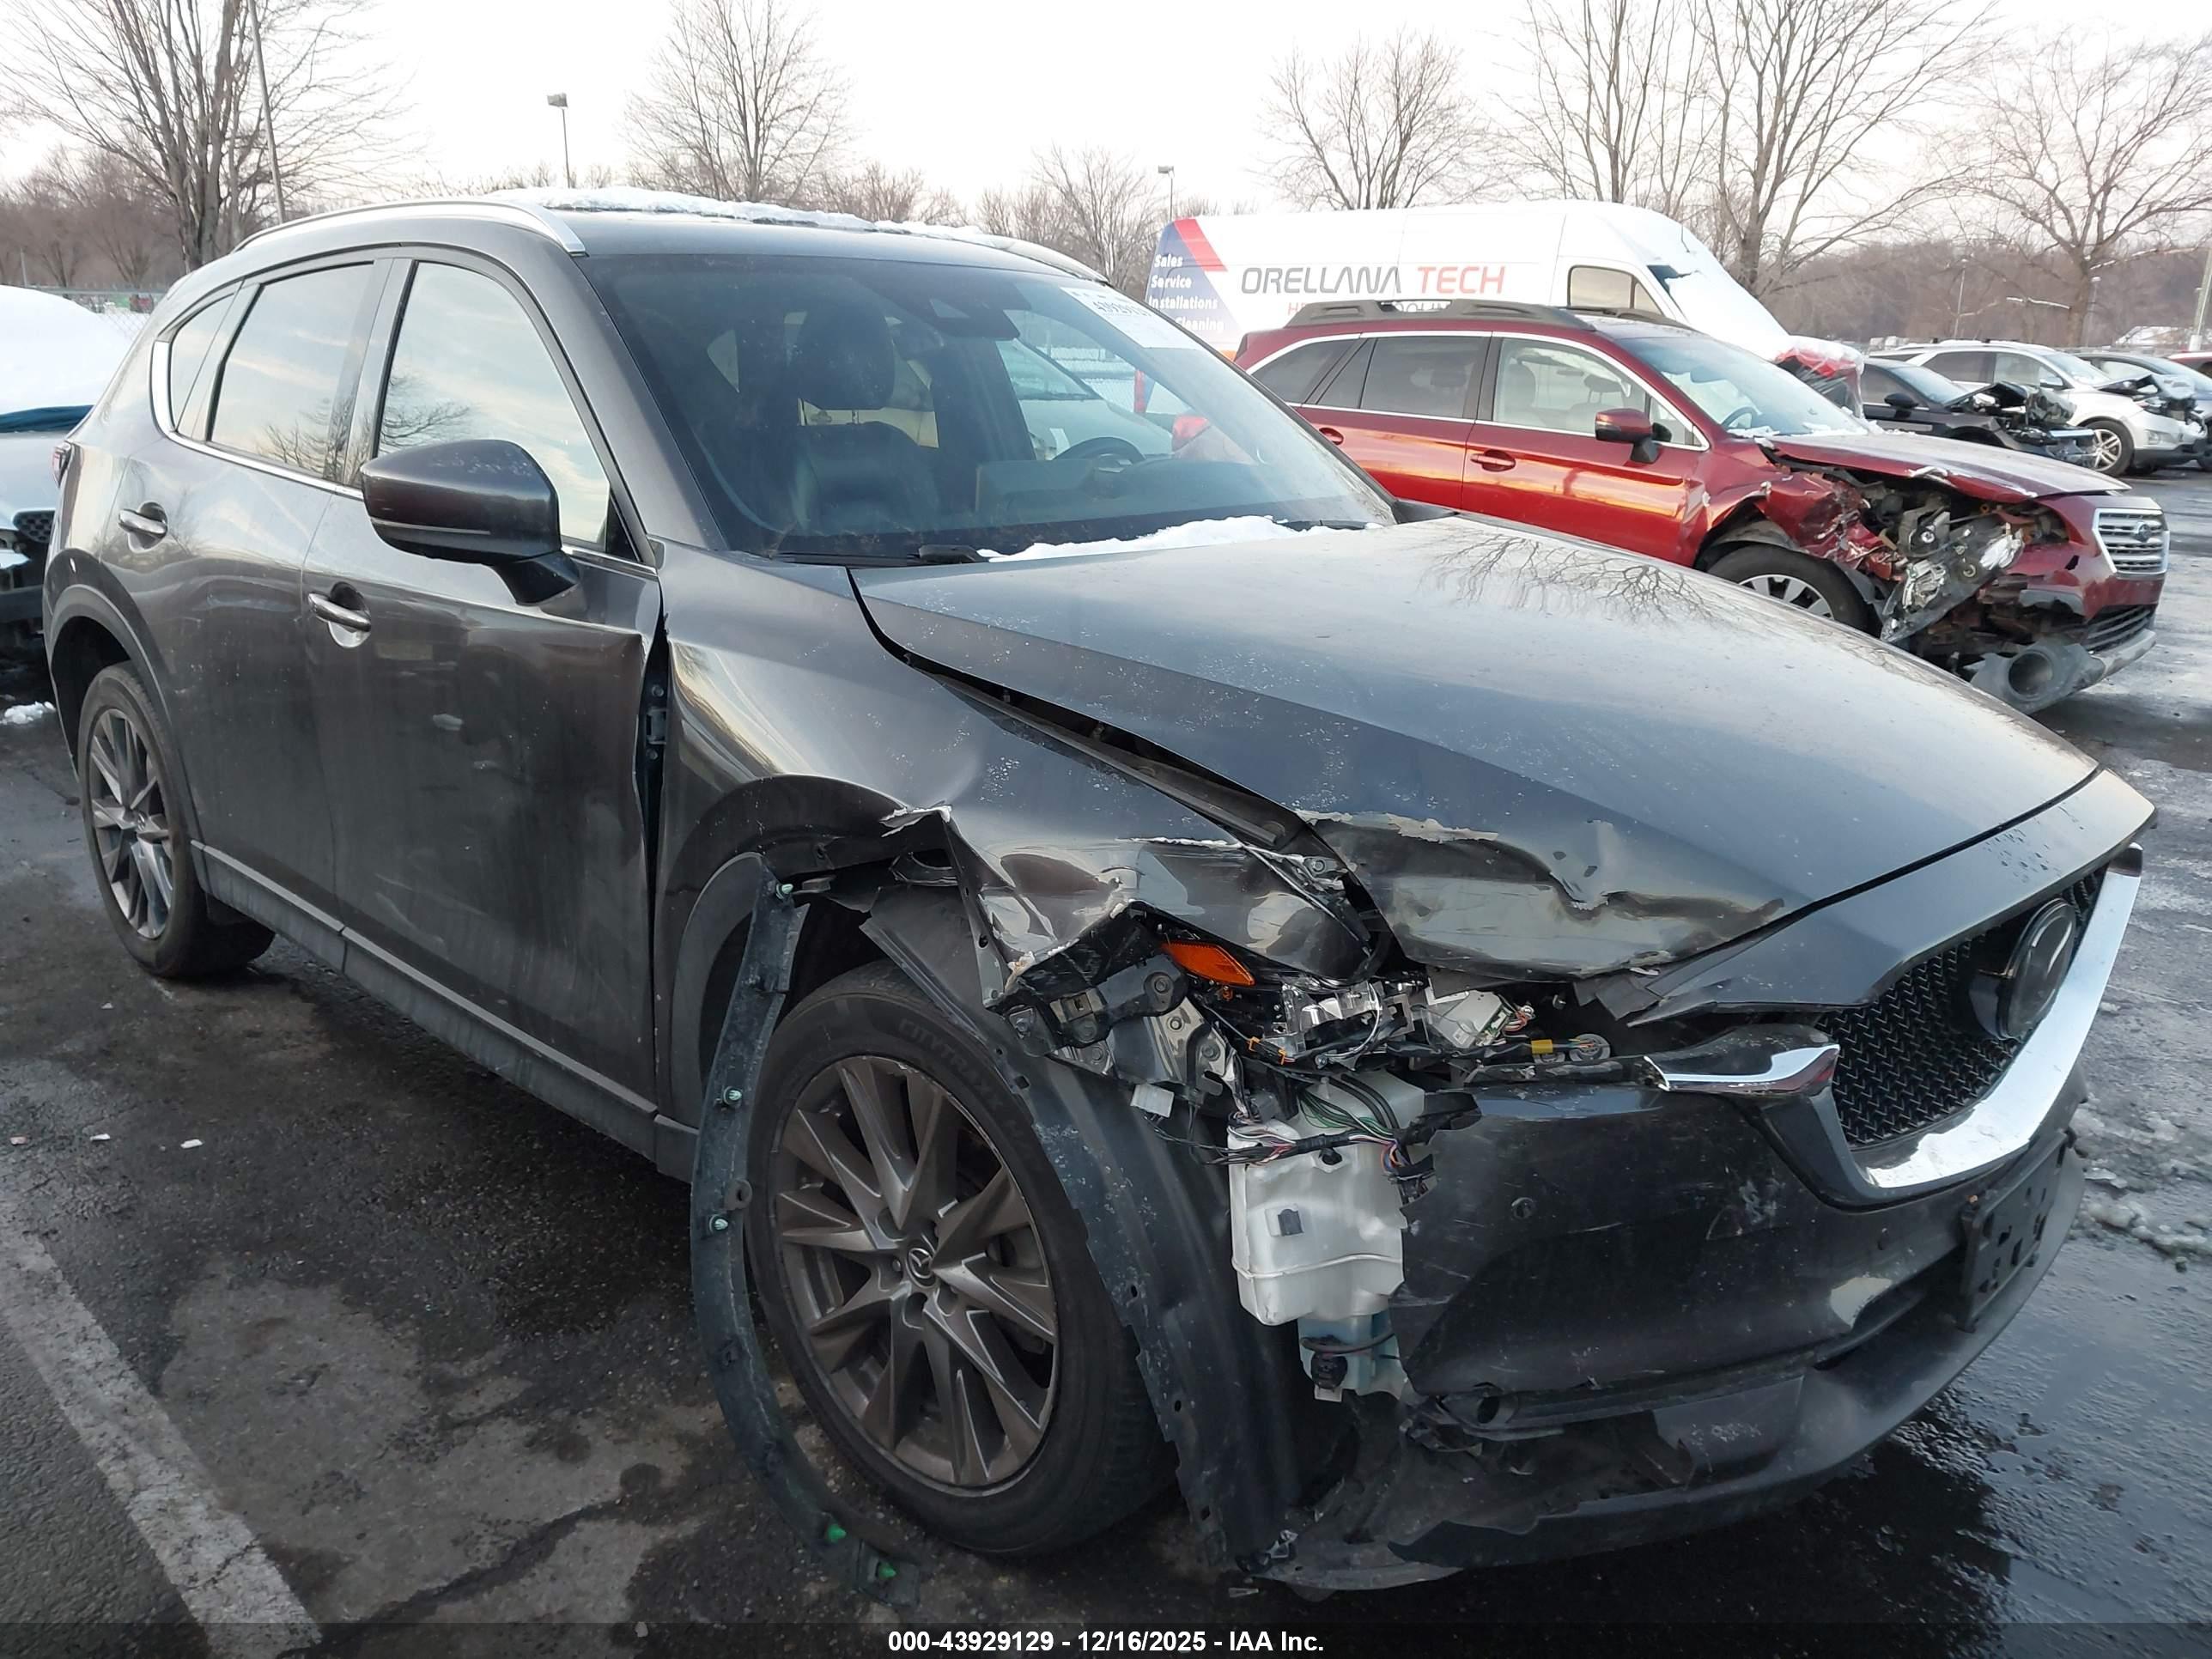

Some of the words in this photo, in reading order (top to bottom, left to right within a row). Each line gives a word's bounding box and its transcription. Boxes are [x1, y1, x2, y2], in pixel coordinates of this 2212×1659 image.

[1154, 253, 1183, 268] Sales
[1151, 274, 1192, 289] Service
[1241, 266, 1401, 294] ORELLANA
[1417, 266, 1504, 294] TECH
[1148, 295, 1218, 310] Installations
